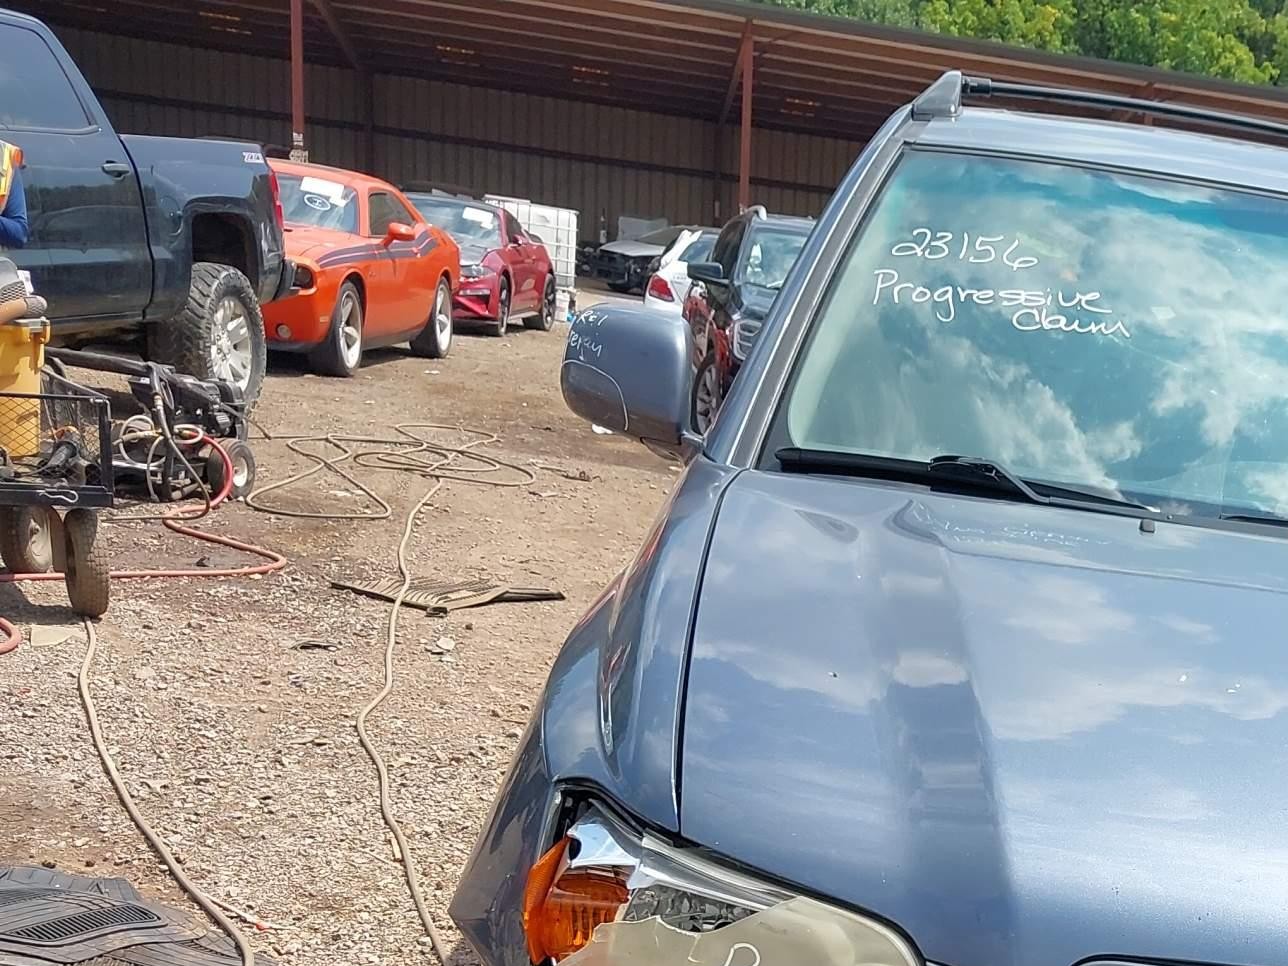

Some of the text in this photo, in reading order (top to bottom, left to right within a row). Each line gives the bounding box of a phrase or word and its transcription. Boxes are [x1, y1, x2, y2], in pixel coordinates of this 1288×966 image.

[891, 228, 1039, 271] 23156
[873, 269, 1113, 322] Progressive
[1011, 307, 1131, 338] Claim
